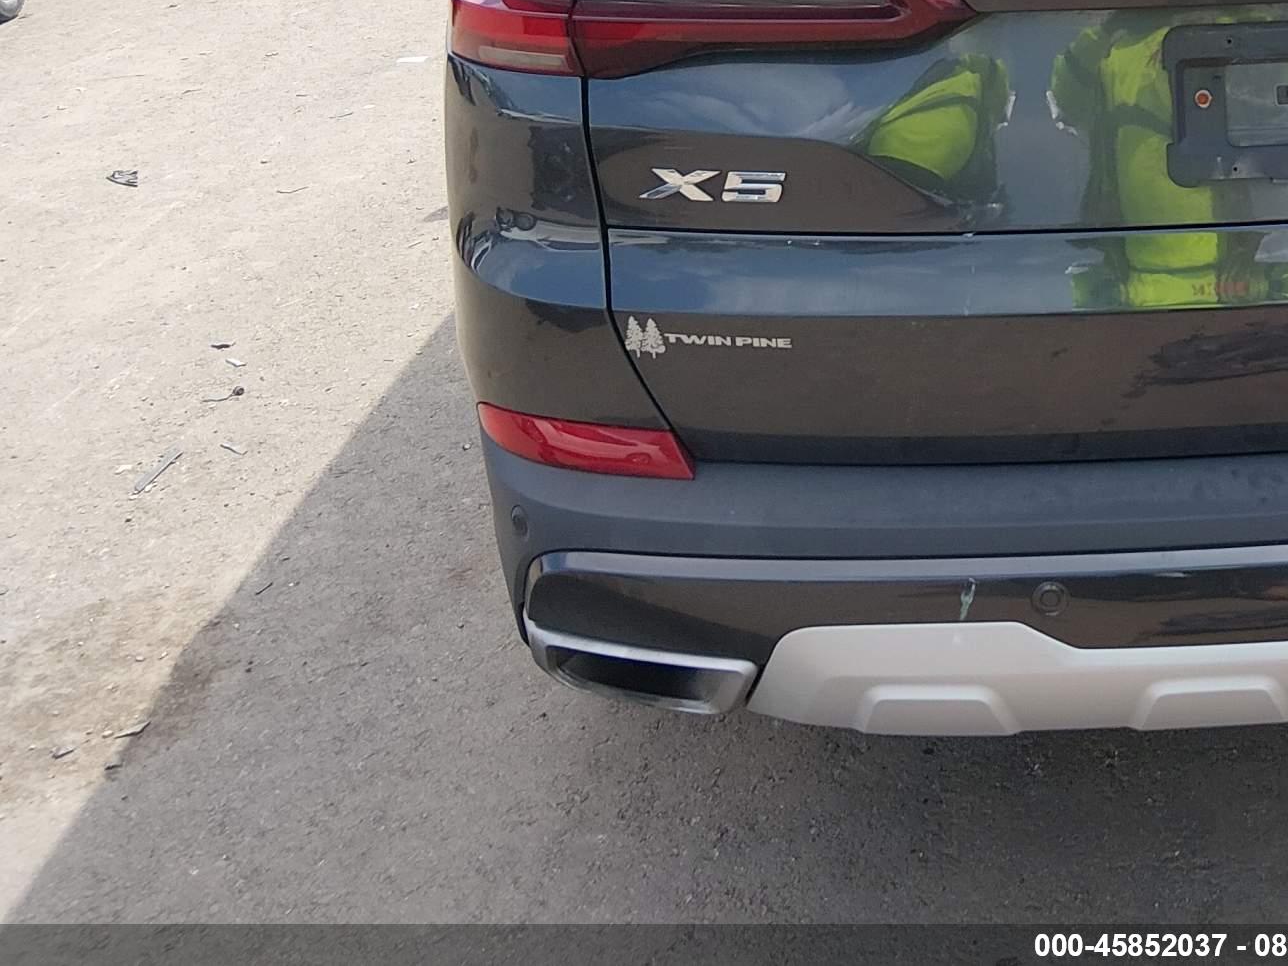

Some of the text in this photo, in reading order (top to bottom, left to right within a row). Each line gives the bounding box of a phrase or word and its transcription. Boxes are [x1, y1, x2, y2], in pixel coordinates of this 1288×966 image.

[639, 168, 786, 203] X5
[663, 333, 793, 349] TWIN PINE
